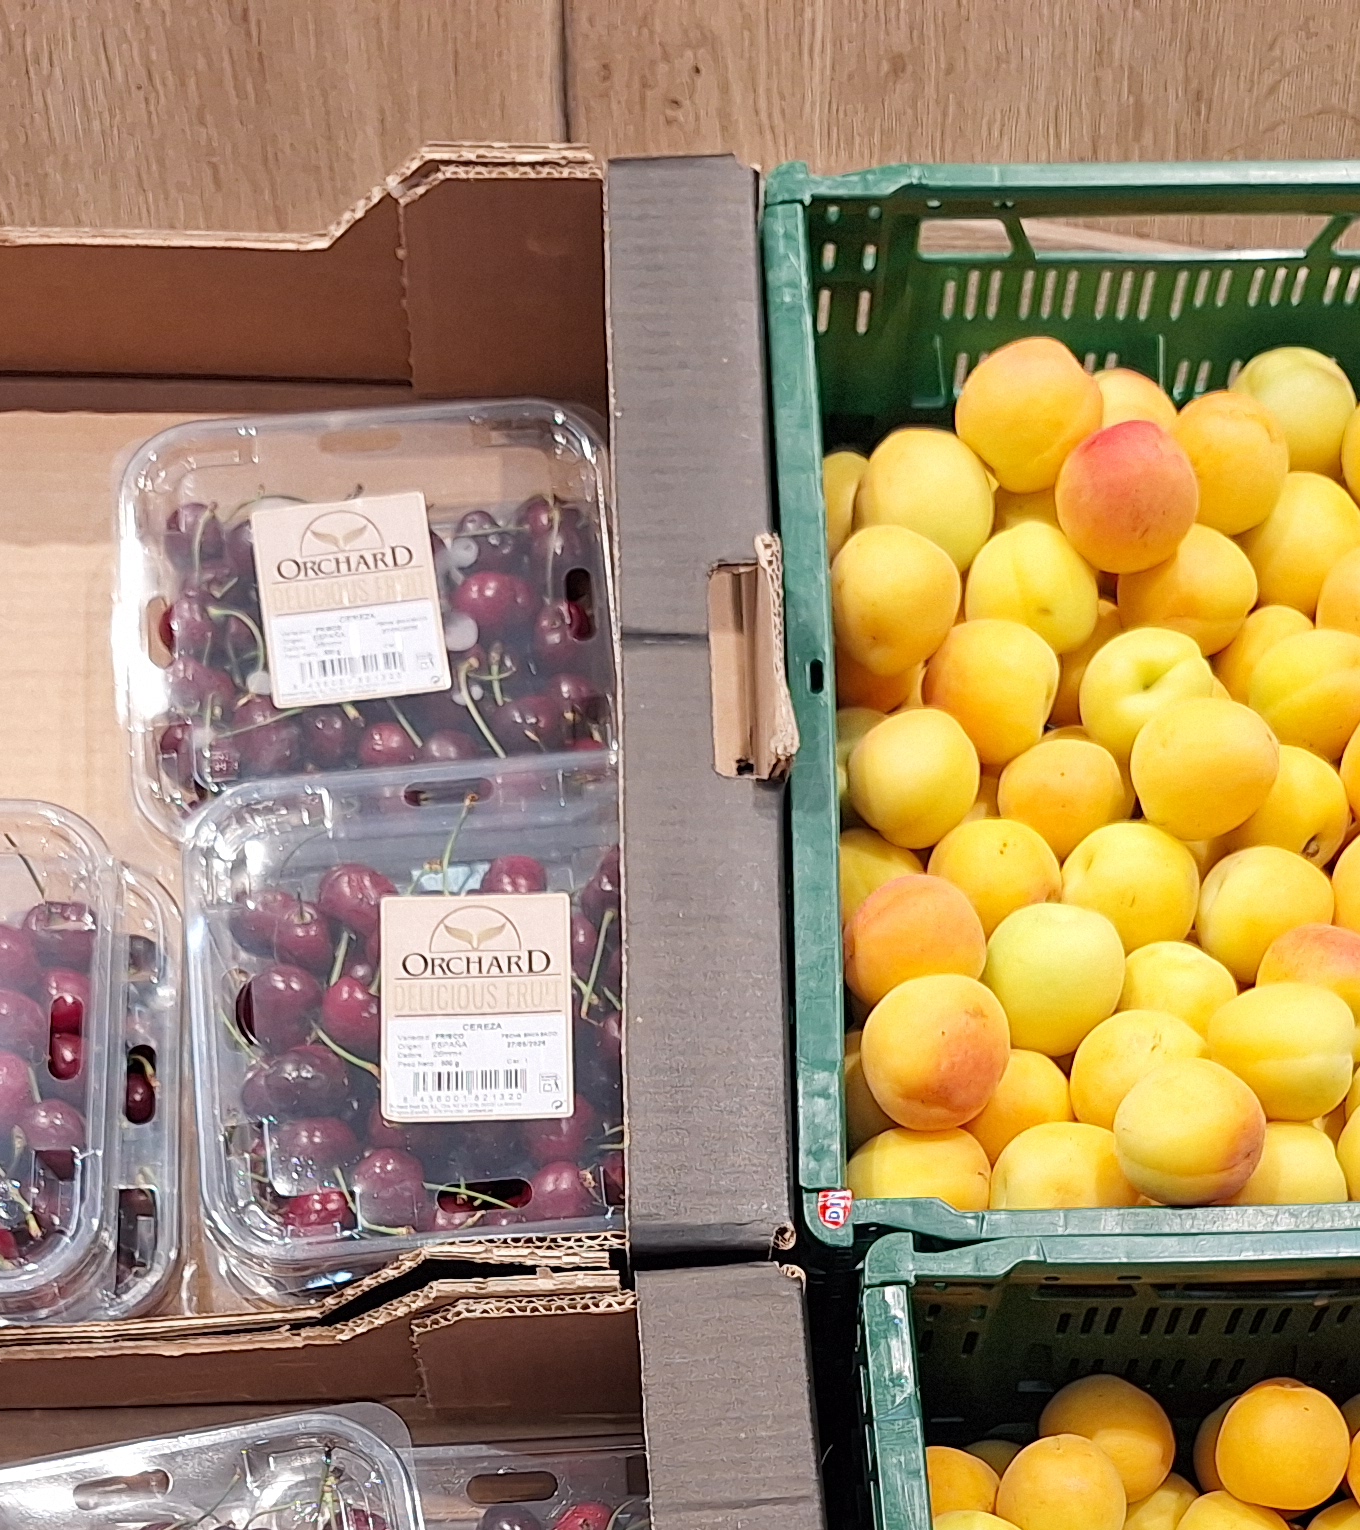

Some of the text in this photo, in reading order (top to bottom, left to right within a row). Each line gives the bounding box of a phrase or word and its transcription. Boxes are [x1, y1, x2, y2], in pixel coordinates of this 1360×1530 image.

[275, 544, 414, 580] ORCHARD
[401, 949, 551, 976] ORCHARD
[393, 981, 497, 1011] DELICIOUS
[462, 1022, 502, 1030] CEREZA
